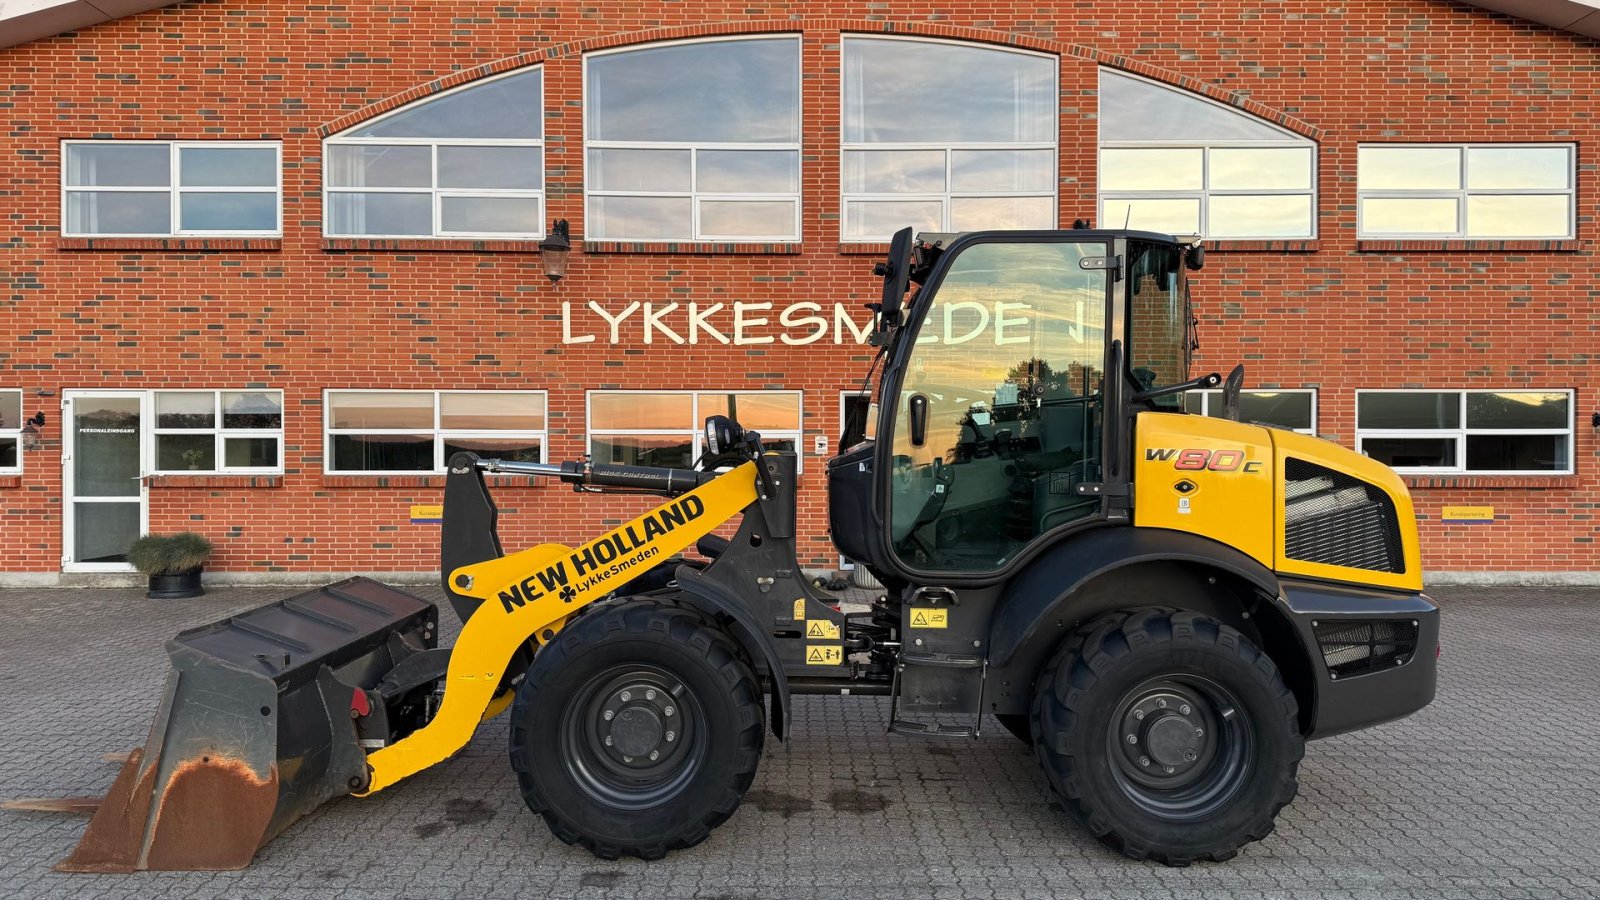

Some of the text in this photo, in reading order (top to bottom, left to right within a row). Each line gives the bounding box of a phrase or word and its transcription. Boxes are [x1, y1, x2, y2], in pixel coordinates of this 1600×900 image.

[497, 494, 705, 614] NEW HOLLAND
[575, 546, 660, 593] LykkeSmeden
